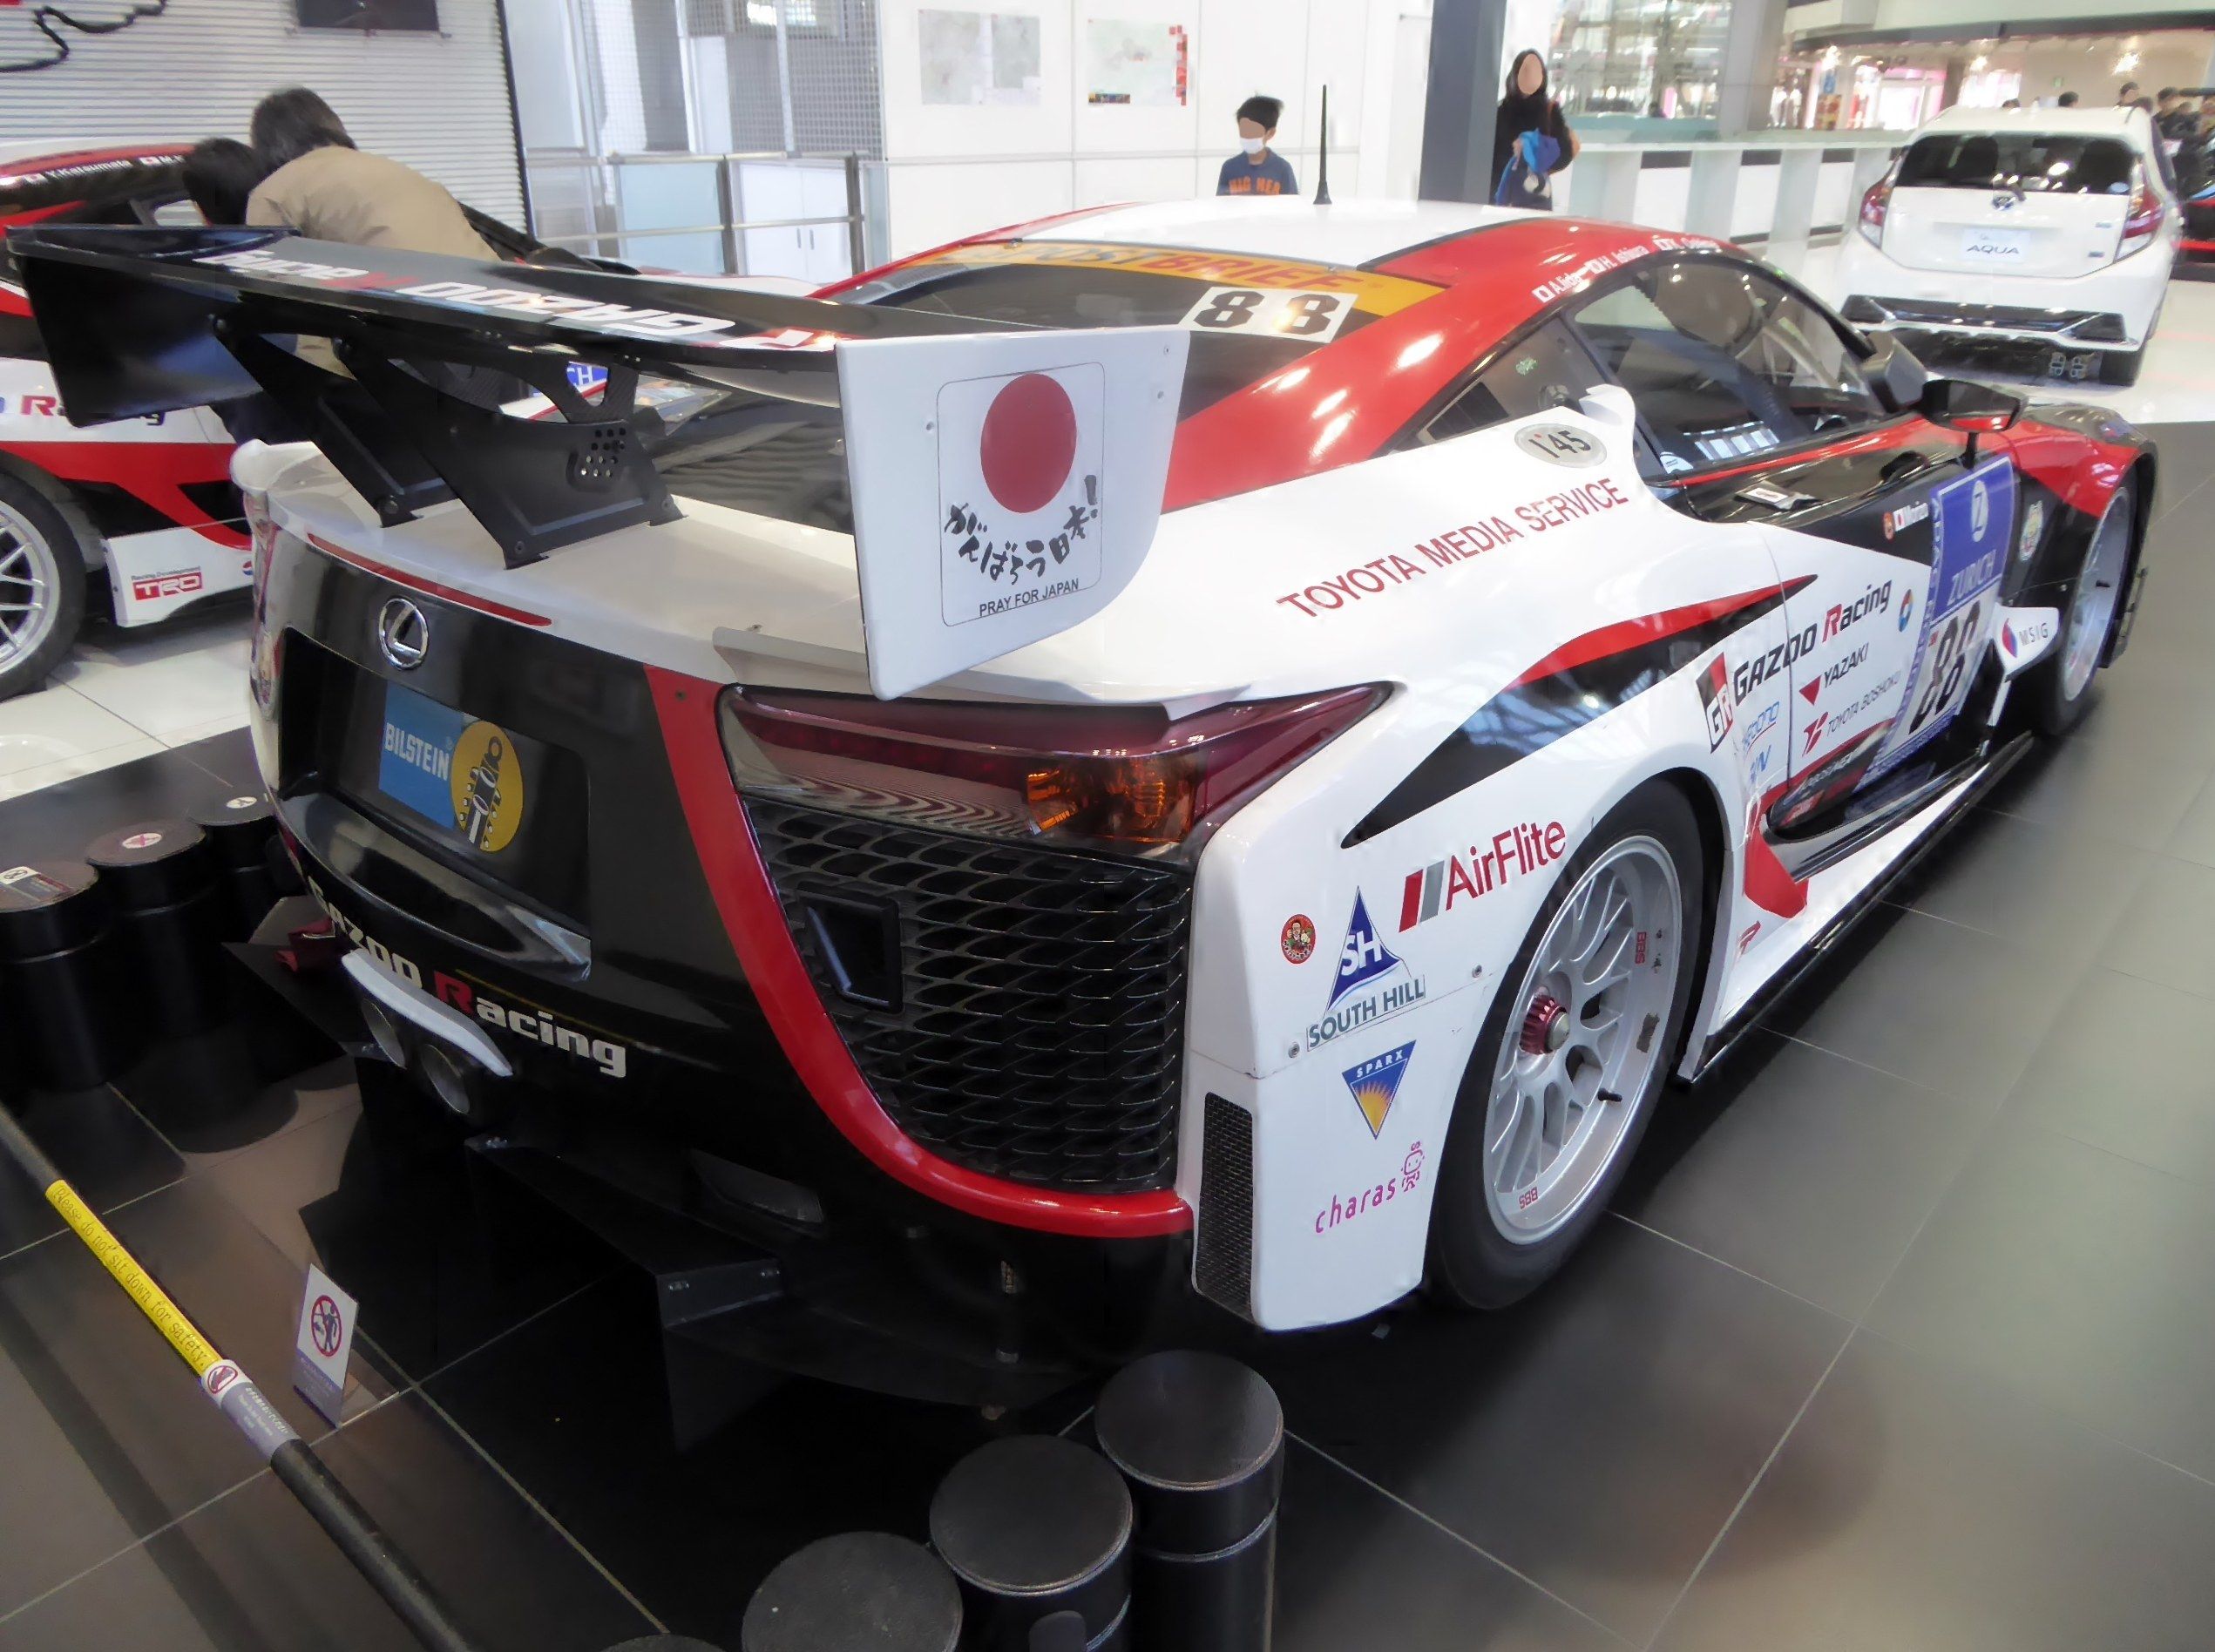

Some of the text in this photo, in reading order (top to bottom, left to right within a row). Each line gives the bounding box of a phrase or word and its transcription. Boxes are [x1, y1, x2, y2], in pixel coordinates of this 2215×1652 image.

[1967, 244, 2020, 255] AQUA
[395, 281, 736, 336] GAZOO
[1194, 290, 1342, 335] 88
[1275, 477, 1629, 618] TOYOTA MEDIA SERVICE
[979, 577, 1080, 617] PRAY FOR JAPAN
[1947, 549, 1997, 607] ZURICH
[1733, 622, 1819, 708] GAZOO
[1822, 579, 1893, 644] Racing
[2017, 621, 2049, 647] MSIG
[1823, 641, 1870, 689] YAZAKI
[1826, 701, 1859, 737] TOYOTA
[383, 721, 450, 782] BILSTEIN
[1445, 821, 1567, 911] AirFlite
[1340, 930, 1383, 978] SH
[1635, 931, 1647, 965] BBS
[433, 970, 627, 1080] Racing
[1308, 978, 1425, 1047] SOUTH HILL
[1356, 1049, 1405, 1079] SPARX
[1315, 1177, 1397, 1234] charas
[52, 1186, 83, 1221] Please
[80, 1222, 95, 1237] do
[91, 1234, 117, 1257] not
[109, 1252, 131, 1275] sit
[125, 1272, 153, 1303] down
[150, 1299, 172, 1323] for
